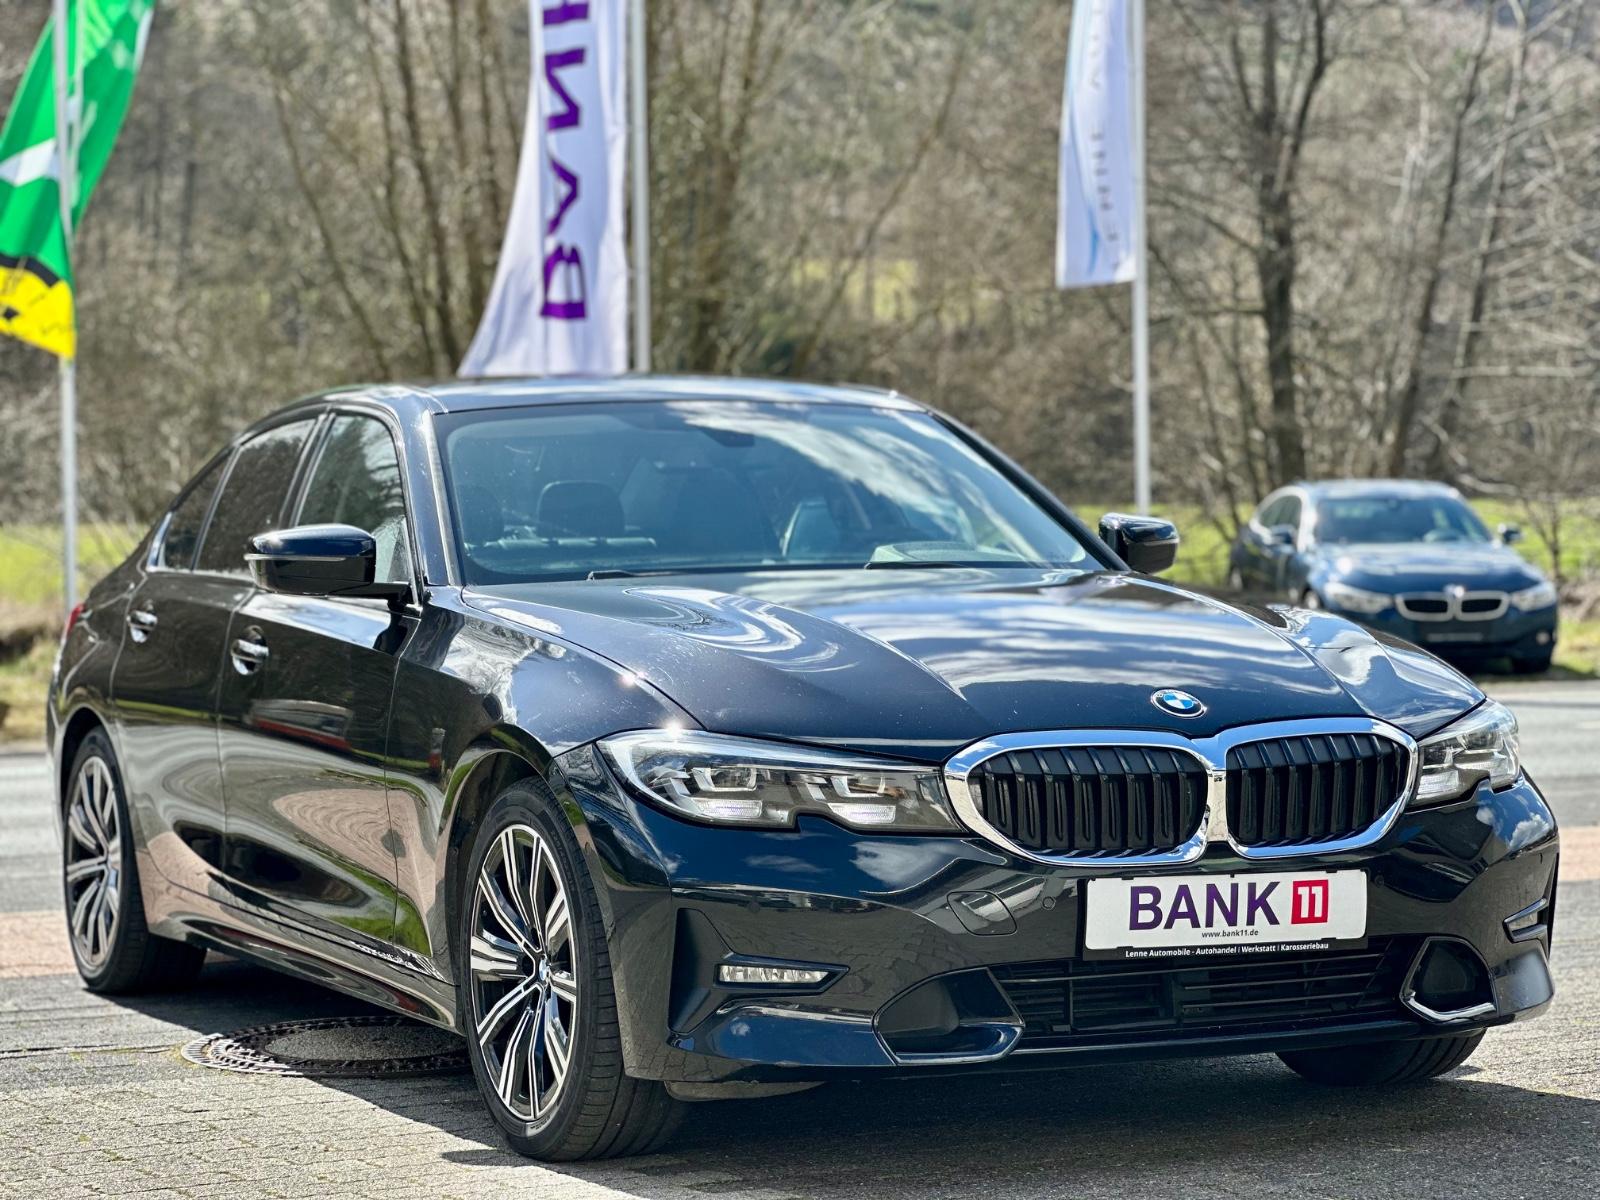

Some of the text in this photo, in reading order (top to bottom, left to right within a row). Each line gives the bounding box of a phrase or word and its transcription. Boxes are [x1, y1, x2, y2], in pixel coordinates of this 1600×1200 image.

[1129, 881, 1325, 930] BANK 11
[1201, 929, 1259, 939] www.bank11.de
[1125, 950, 1148, 958] Lenne
[1148, 948, 1191, 957] Automobile
[1195, 947, 1237, 955] Autohandel
[1241, 945, 1276, 953] Werkstatt
[1280, 942, 1329, 951] Karosseriebau
